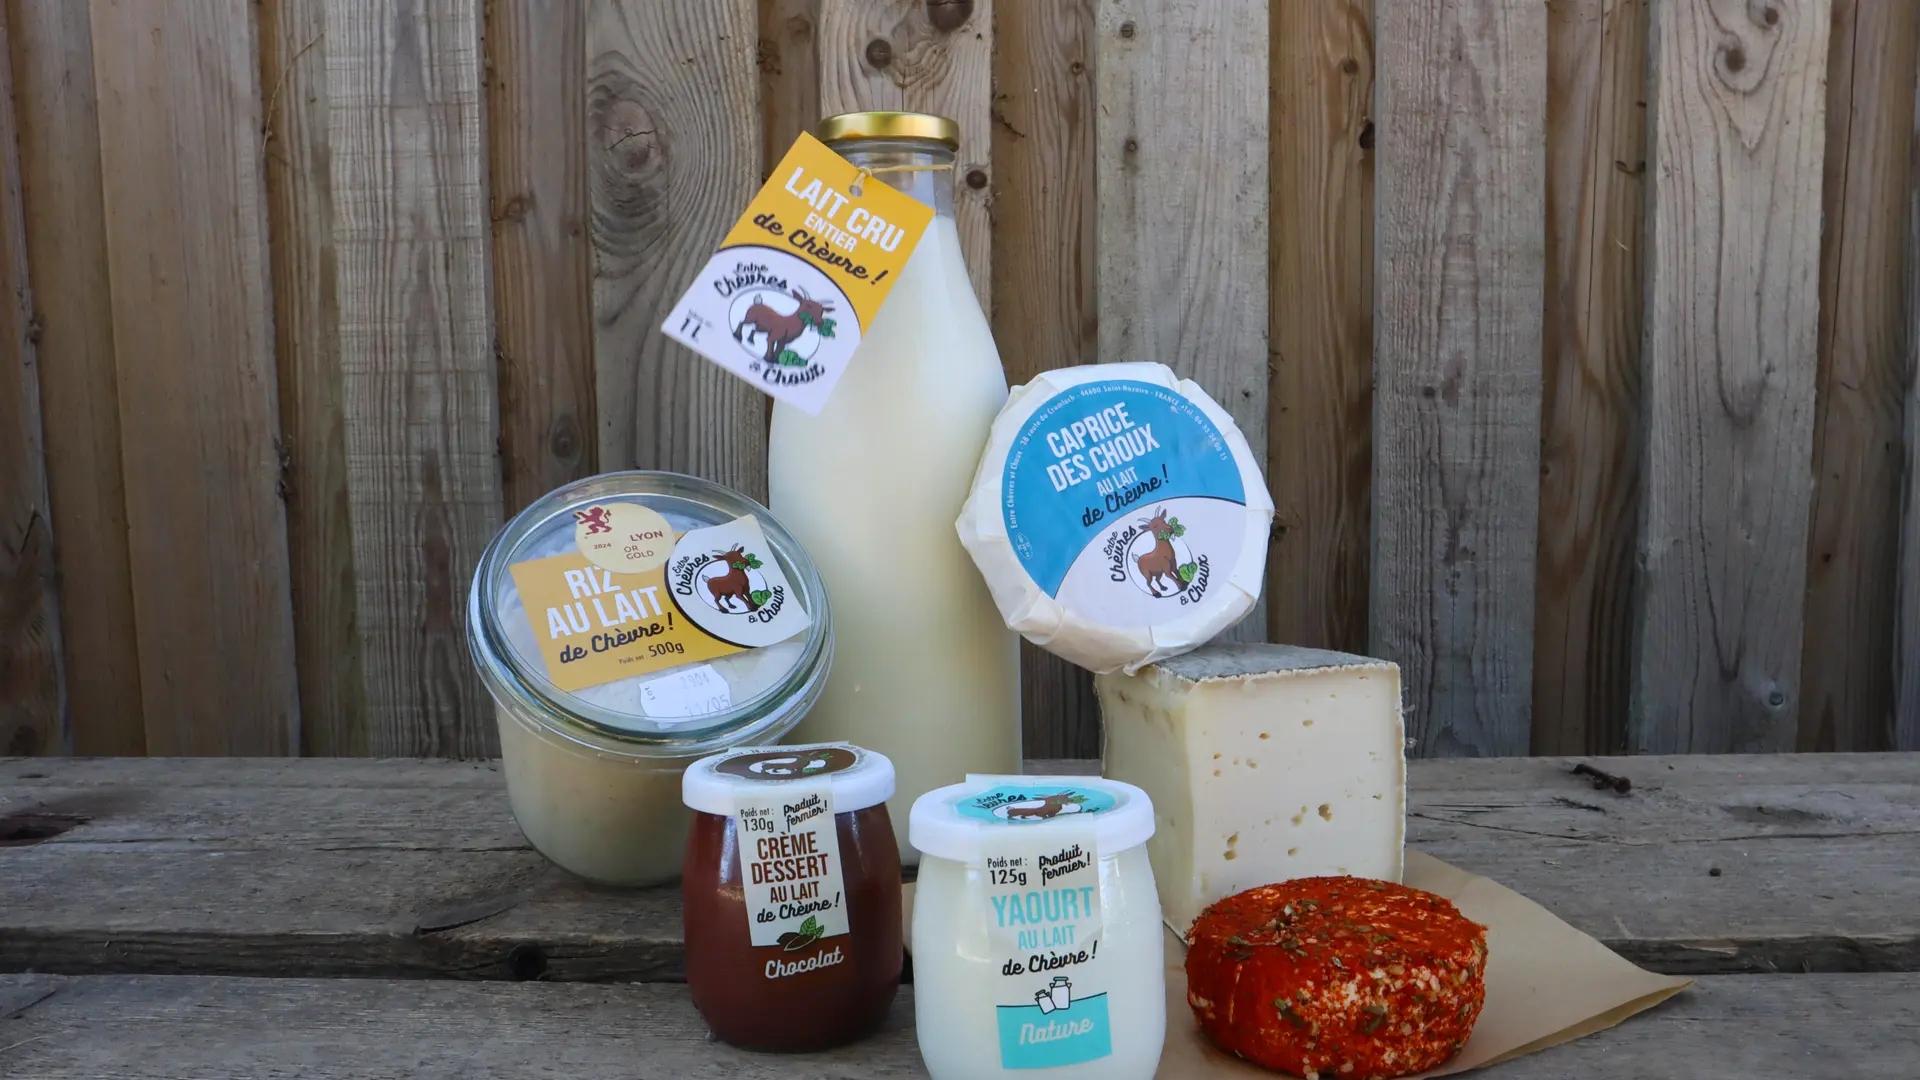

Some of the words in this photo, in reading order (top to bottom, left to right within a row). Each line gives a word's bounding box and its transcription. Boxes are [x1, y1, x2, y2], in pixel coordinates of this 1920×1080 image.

[785, 166, 849, 219] LAIT
[846, 208, 905, 252] CRU
[804, 212, 857, 253] ENTIER
[753, 213, 784, 236] de
[788, 229, 868, 279] Chèvre
[736, 262, 768, 273] Entre
[763, 363, 825, 385] Choux
[1154, 390, 1180, 406] FRANCE
[1027, 421, 1041, 437] route
[1039, 414, 1048, 422] du
[1047, 401, 1135, 458] CAPRICE
[1010, 451, 1023, 470] Choux
[1046, 454, 1092, 492] DES
[1089, 423, 1160, 472] CHOUX
[1096, 477, 1114, 496] AU
[1112, 466, 1139, 489] LAIT
[1082, 506, 1104, 527] de
[1105, 476, 1162, 513] Chèvre
[1009, 509, 1018, 529] Entre
[593, 542, 611, 550] 2024
[630, 530, 663, 541] LYON
[1103, 530, 1118, 556] Entre
[626, 550, 654, 560] GOLD
[672, 555, 690, 574] Entre
[1108, 525, 1137, 582] Chèvres
[564, 566, 621, 599] RIZ
[675, 553, 710, 596] Chèvres
[1180, 595, 1189, 606] &
[1187, 554, 1210, 603] Choux
[546, 602, 591, 639] AU
[592, 586, 663, 627] LAIT
[748, 615, 757, 623] &
[758, 585, 785, 623] Choux
[560, 644, 588, 664] de
[591, 623, 664, 653] Chèvre
[618, 656, 634, 664] Poids
[648, 641, 685, 657] 500g
[740, 807, 758, 818] Poids
[760, 808, 770, 816] net
[783, 793, 820, 817] Produit
[743, 817, 774, 833] 130g
[757, 831, 818, 860] CRÈME
[1038, 843, 1083, 870] Produit
[751, 853, 828, 884] DESSERT
[987, 856, 1008, 868] Poids
[1010, 857, 1022, 867] net
[990, 868, 1027, 886] 125g
[770, 885, 787, 904] AU
[790, 881, 819, 901] LAIT
[757, 908, 776, 923] de
[779, 899, 832, 920] Chèvre
[990, 886, 1094, 927] YAOURT
[1018, 929, 1038, 951] AU
[1042, 925, 1076, 947] LAIT
[765, 945, 844, 979] Chocolat
[1002, 958, 1025, 976] de
[1028, 950, 1089, 973] Chèvre
[1020, 1018, 1095, 1045] Nature
